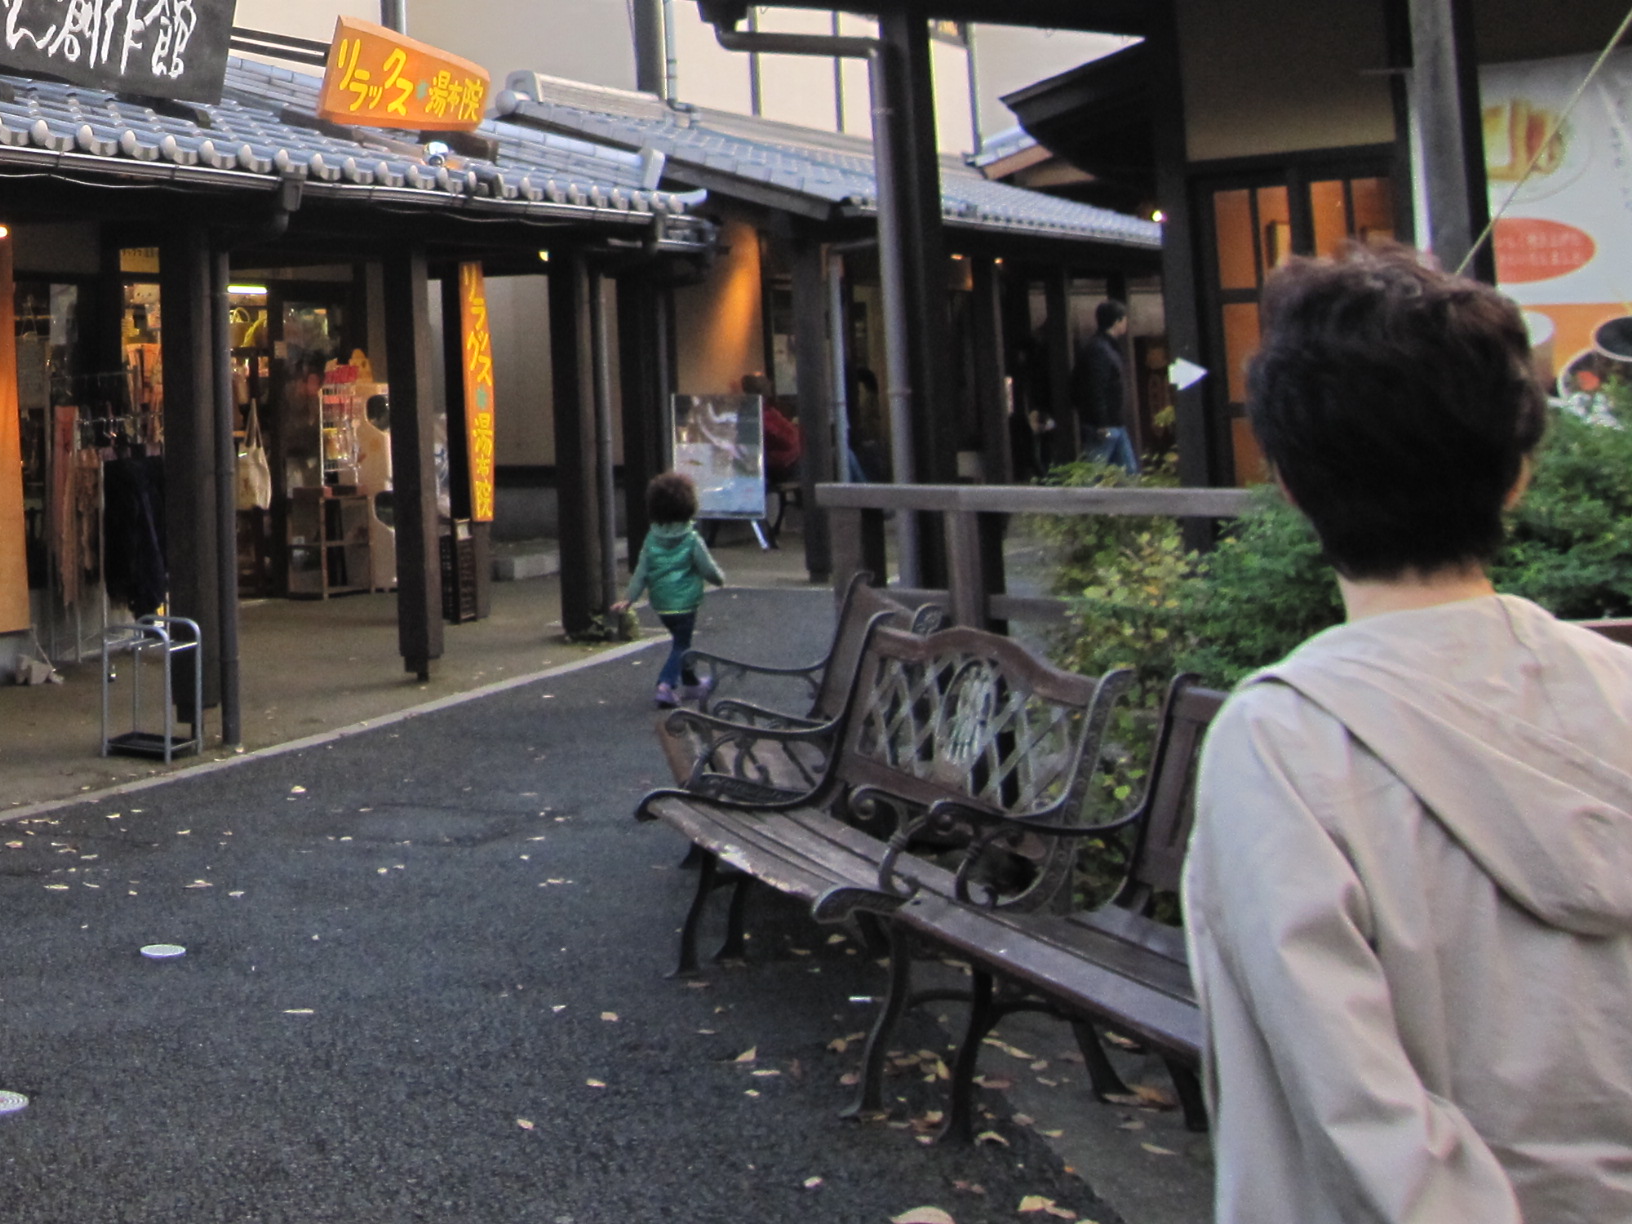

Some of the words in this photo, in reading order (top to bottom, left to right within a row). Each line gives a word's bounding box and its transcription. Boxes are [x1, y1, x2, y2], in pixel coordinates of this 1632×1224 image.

[337, 38, 414, 116] リラックス
[425, 69, 484, 122] 湯布院
[464, 265, 493, 387] リラックス
[472, 413, 493, 519] 湯布院
